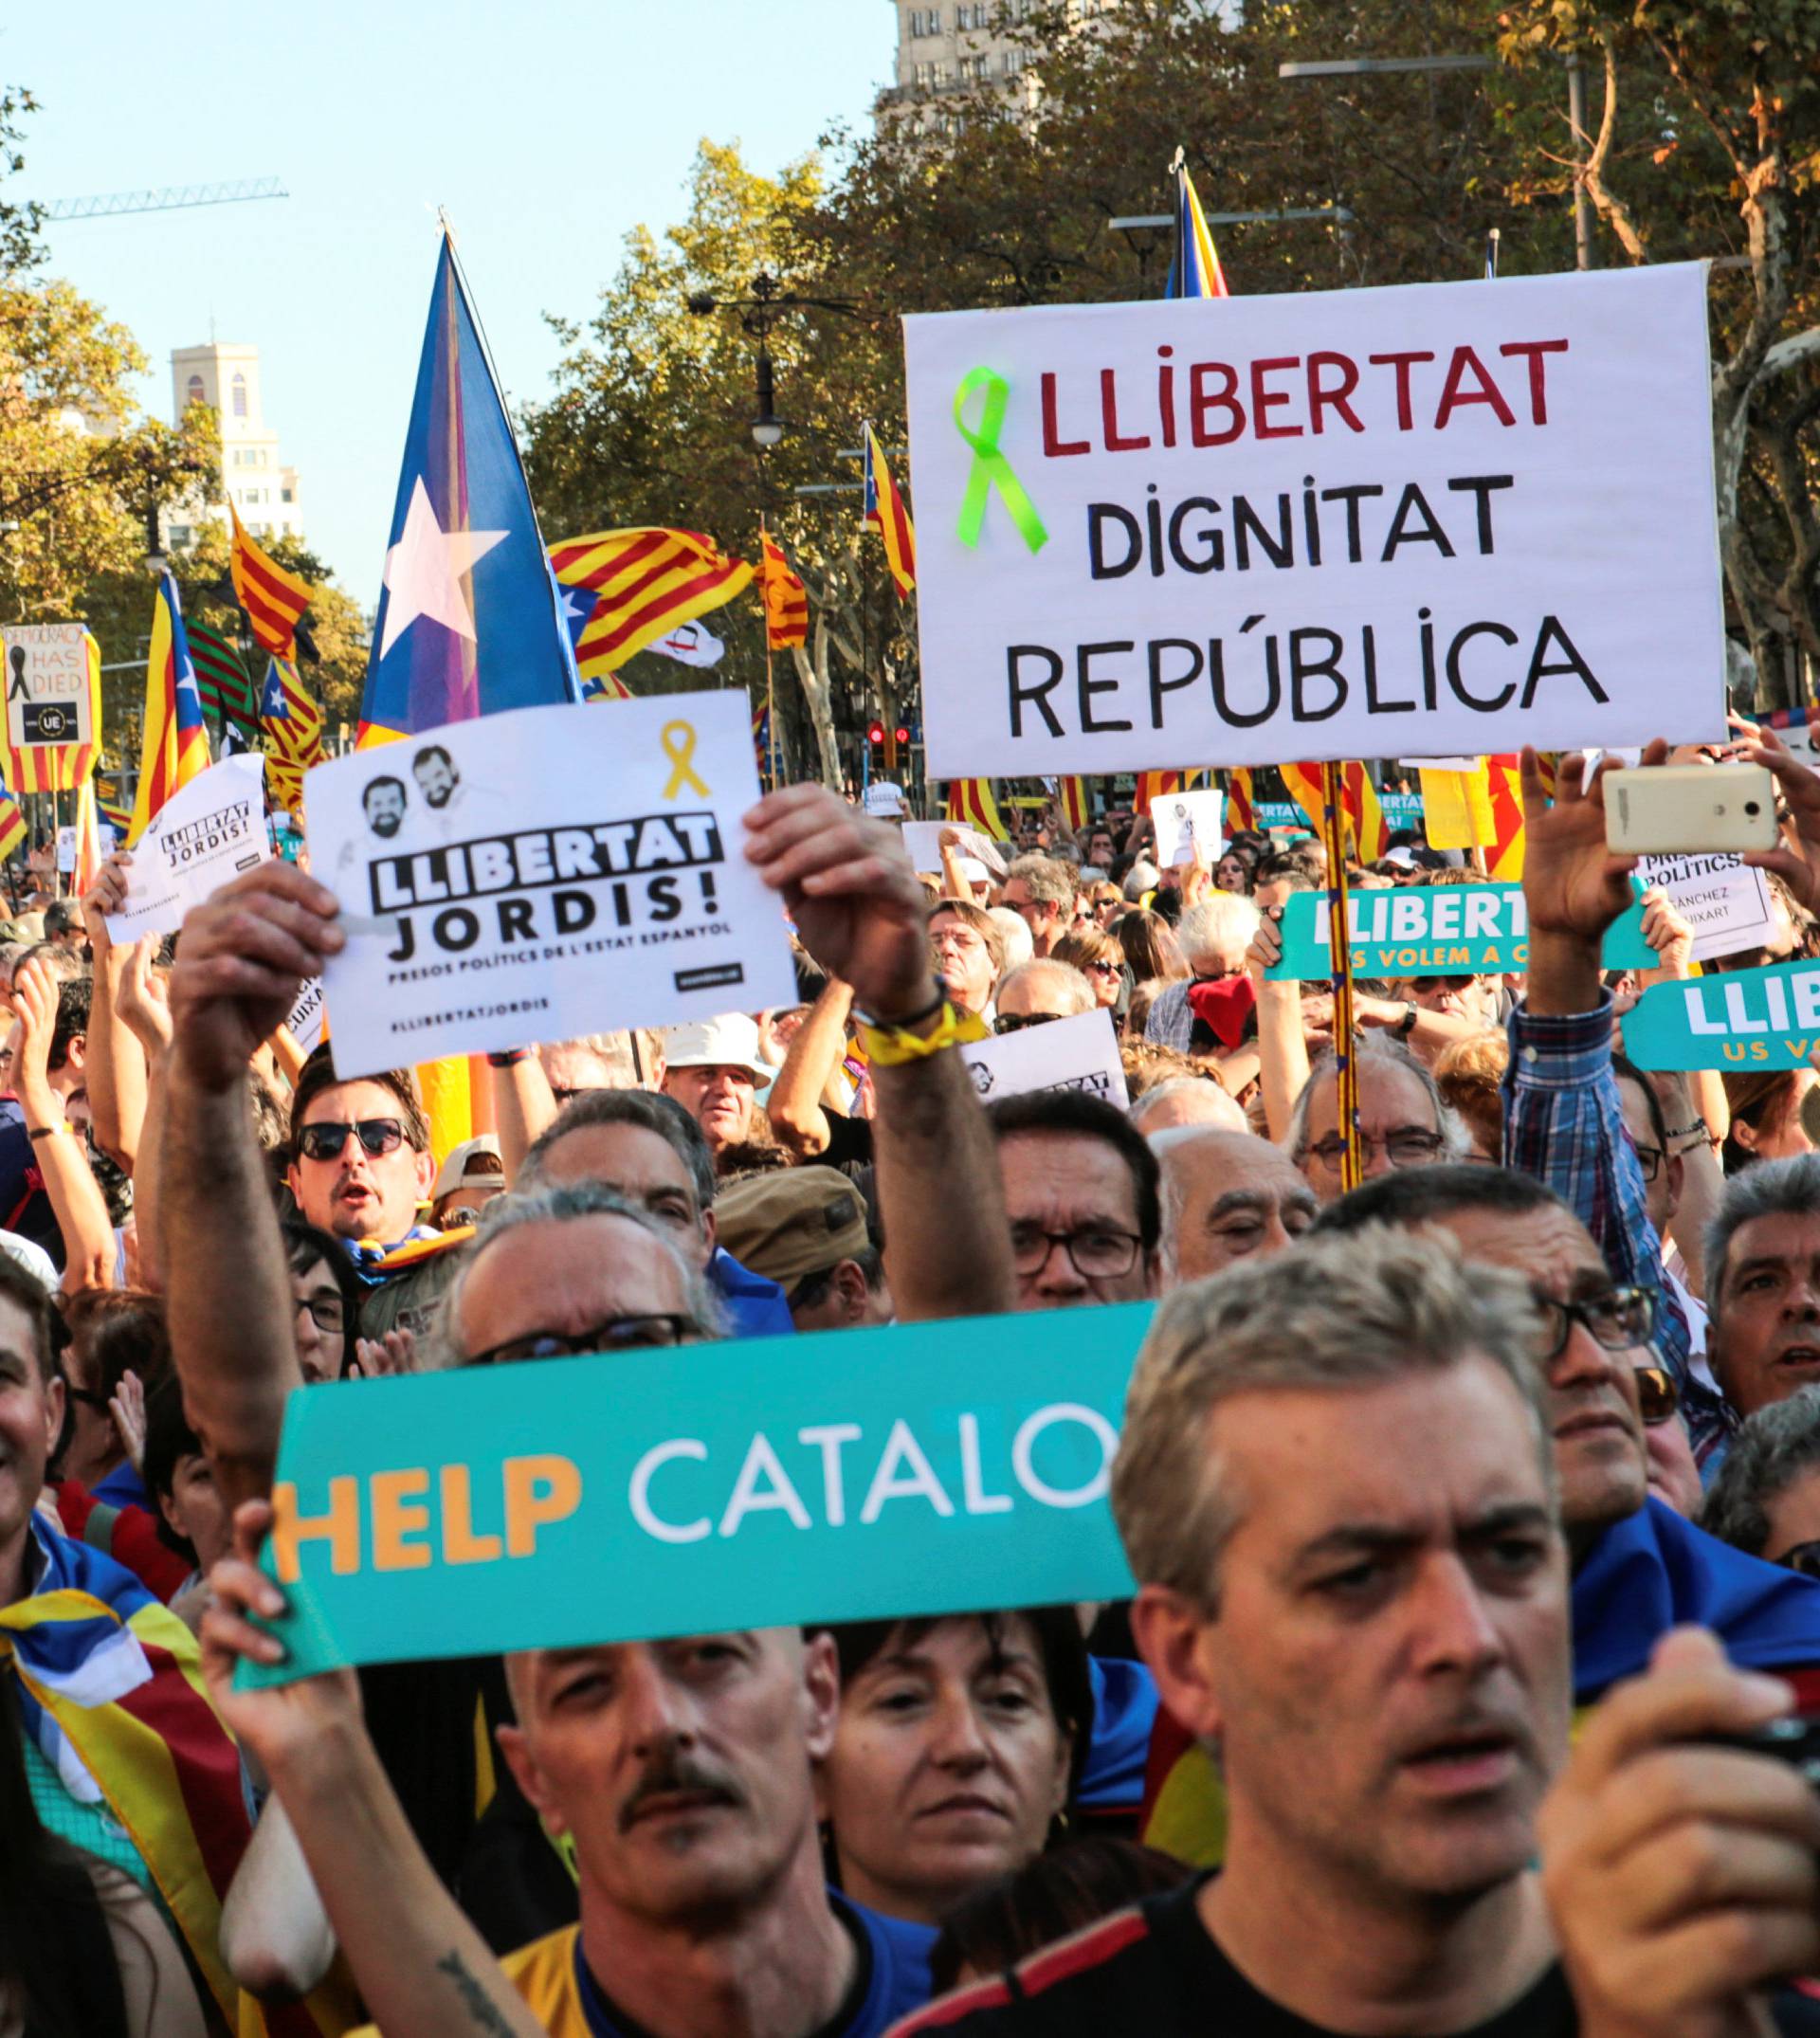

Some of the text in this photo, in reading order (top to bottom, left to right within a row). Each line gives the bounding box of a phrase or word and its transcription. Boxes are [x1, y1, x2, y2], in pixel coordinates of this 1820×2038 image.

[32, 649, 81, 668] HAS
[33, 673, 82, 694] DIED
[44, 715, 61, 730] UE
[170, 820, 249, 866] JORDIS!
[374, 812, 717, 910] LLIBERTAT
[388, 871, 719, 963] JORDIS!
[389, 922, 732, 984] PRESOS POLÍTICS DE L'ESTAT ESPANYOL
[1379, 946, 1470, 968] VOLEM
[1482, 945, 1501, 964] A
[1722, 1040, 1770, 1061] US
[273, 1453, 583, 1584] HELP
